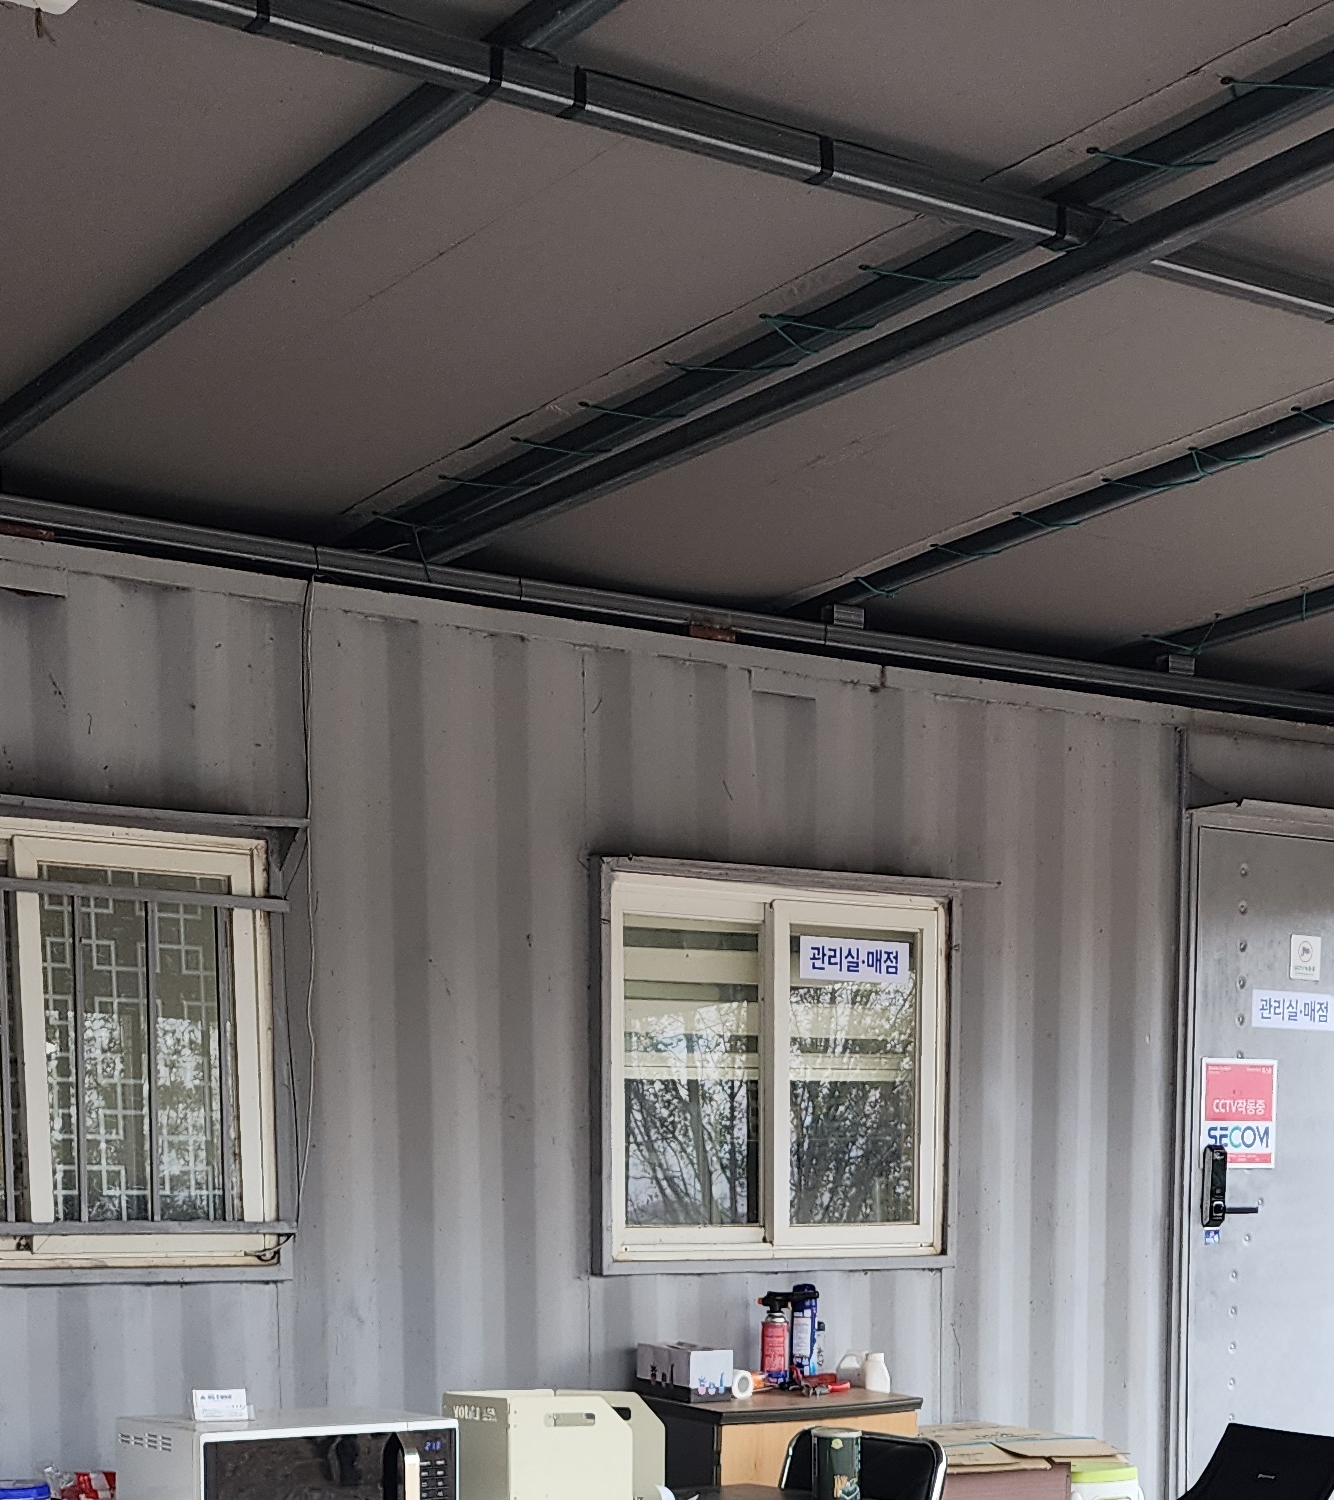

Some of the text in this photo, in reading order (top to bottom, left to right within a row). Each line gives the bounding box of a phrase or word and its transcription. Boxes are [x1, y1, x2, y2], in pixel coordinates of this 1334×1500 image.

[809, 945, 899, 975] 관리실·매점
[1259, 997, 1329, 1023] 관리실·매점
[1212, 1099, 1266, 1116] CCTV작동중
[1207, 1125, 1270, 1149] SECOM
